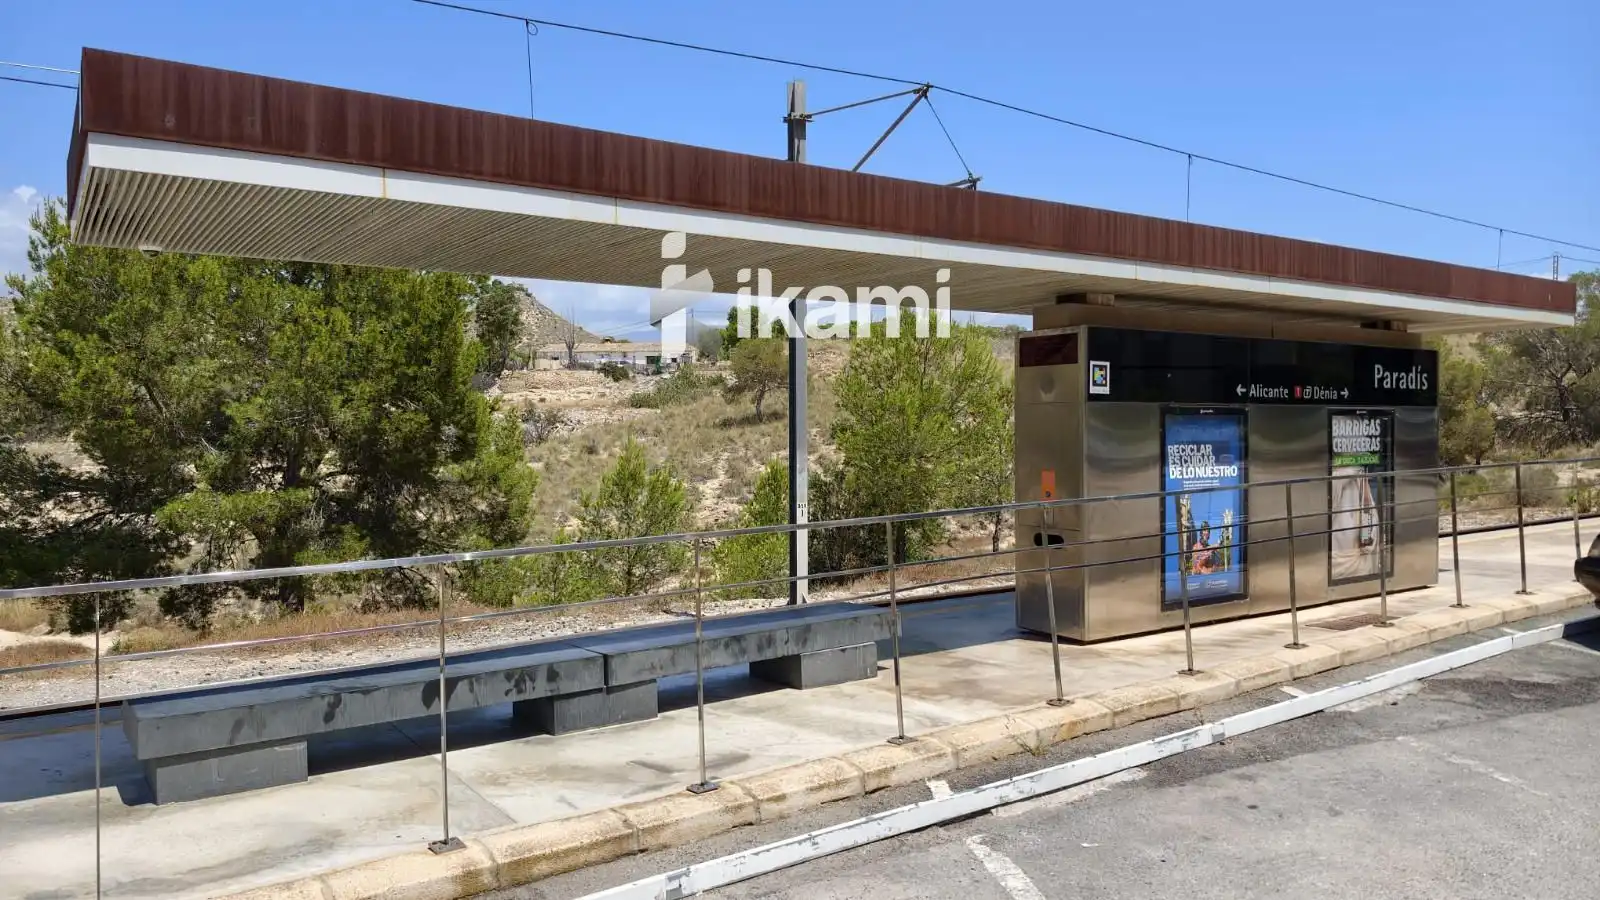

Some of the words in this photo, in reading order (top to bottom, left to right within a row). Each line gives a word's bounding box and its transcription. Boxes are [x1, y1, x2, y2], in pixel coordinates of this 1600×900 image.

[1374, 363, 1429, 390] Paradís
[1249, 383, 1289, 398] Alicante
[1313, 386, 1338, 400] Dénia
[1332, 419, 1381, 436] BARRIGAS
[1168, 444, 1213, 456] RECICLAR
[1332, 437, 1381, 453] CERVECERAS
[1169, 456, 1180, 468] ES
[1181, 455, 1216, 467] CUIDAR
[1169, 466, 1182, 479] DE
[1183, 466, 1195, 479] LO
[1195, 465, 1238, 478] NUESTRO
